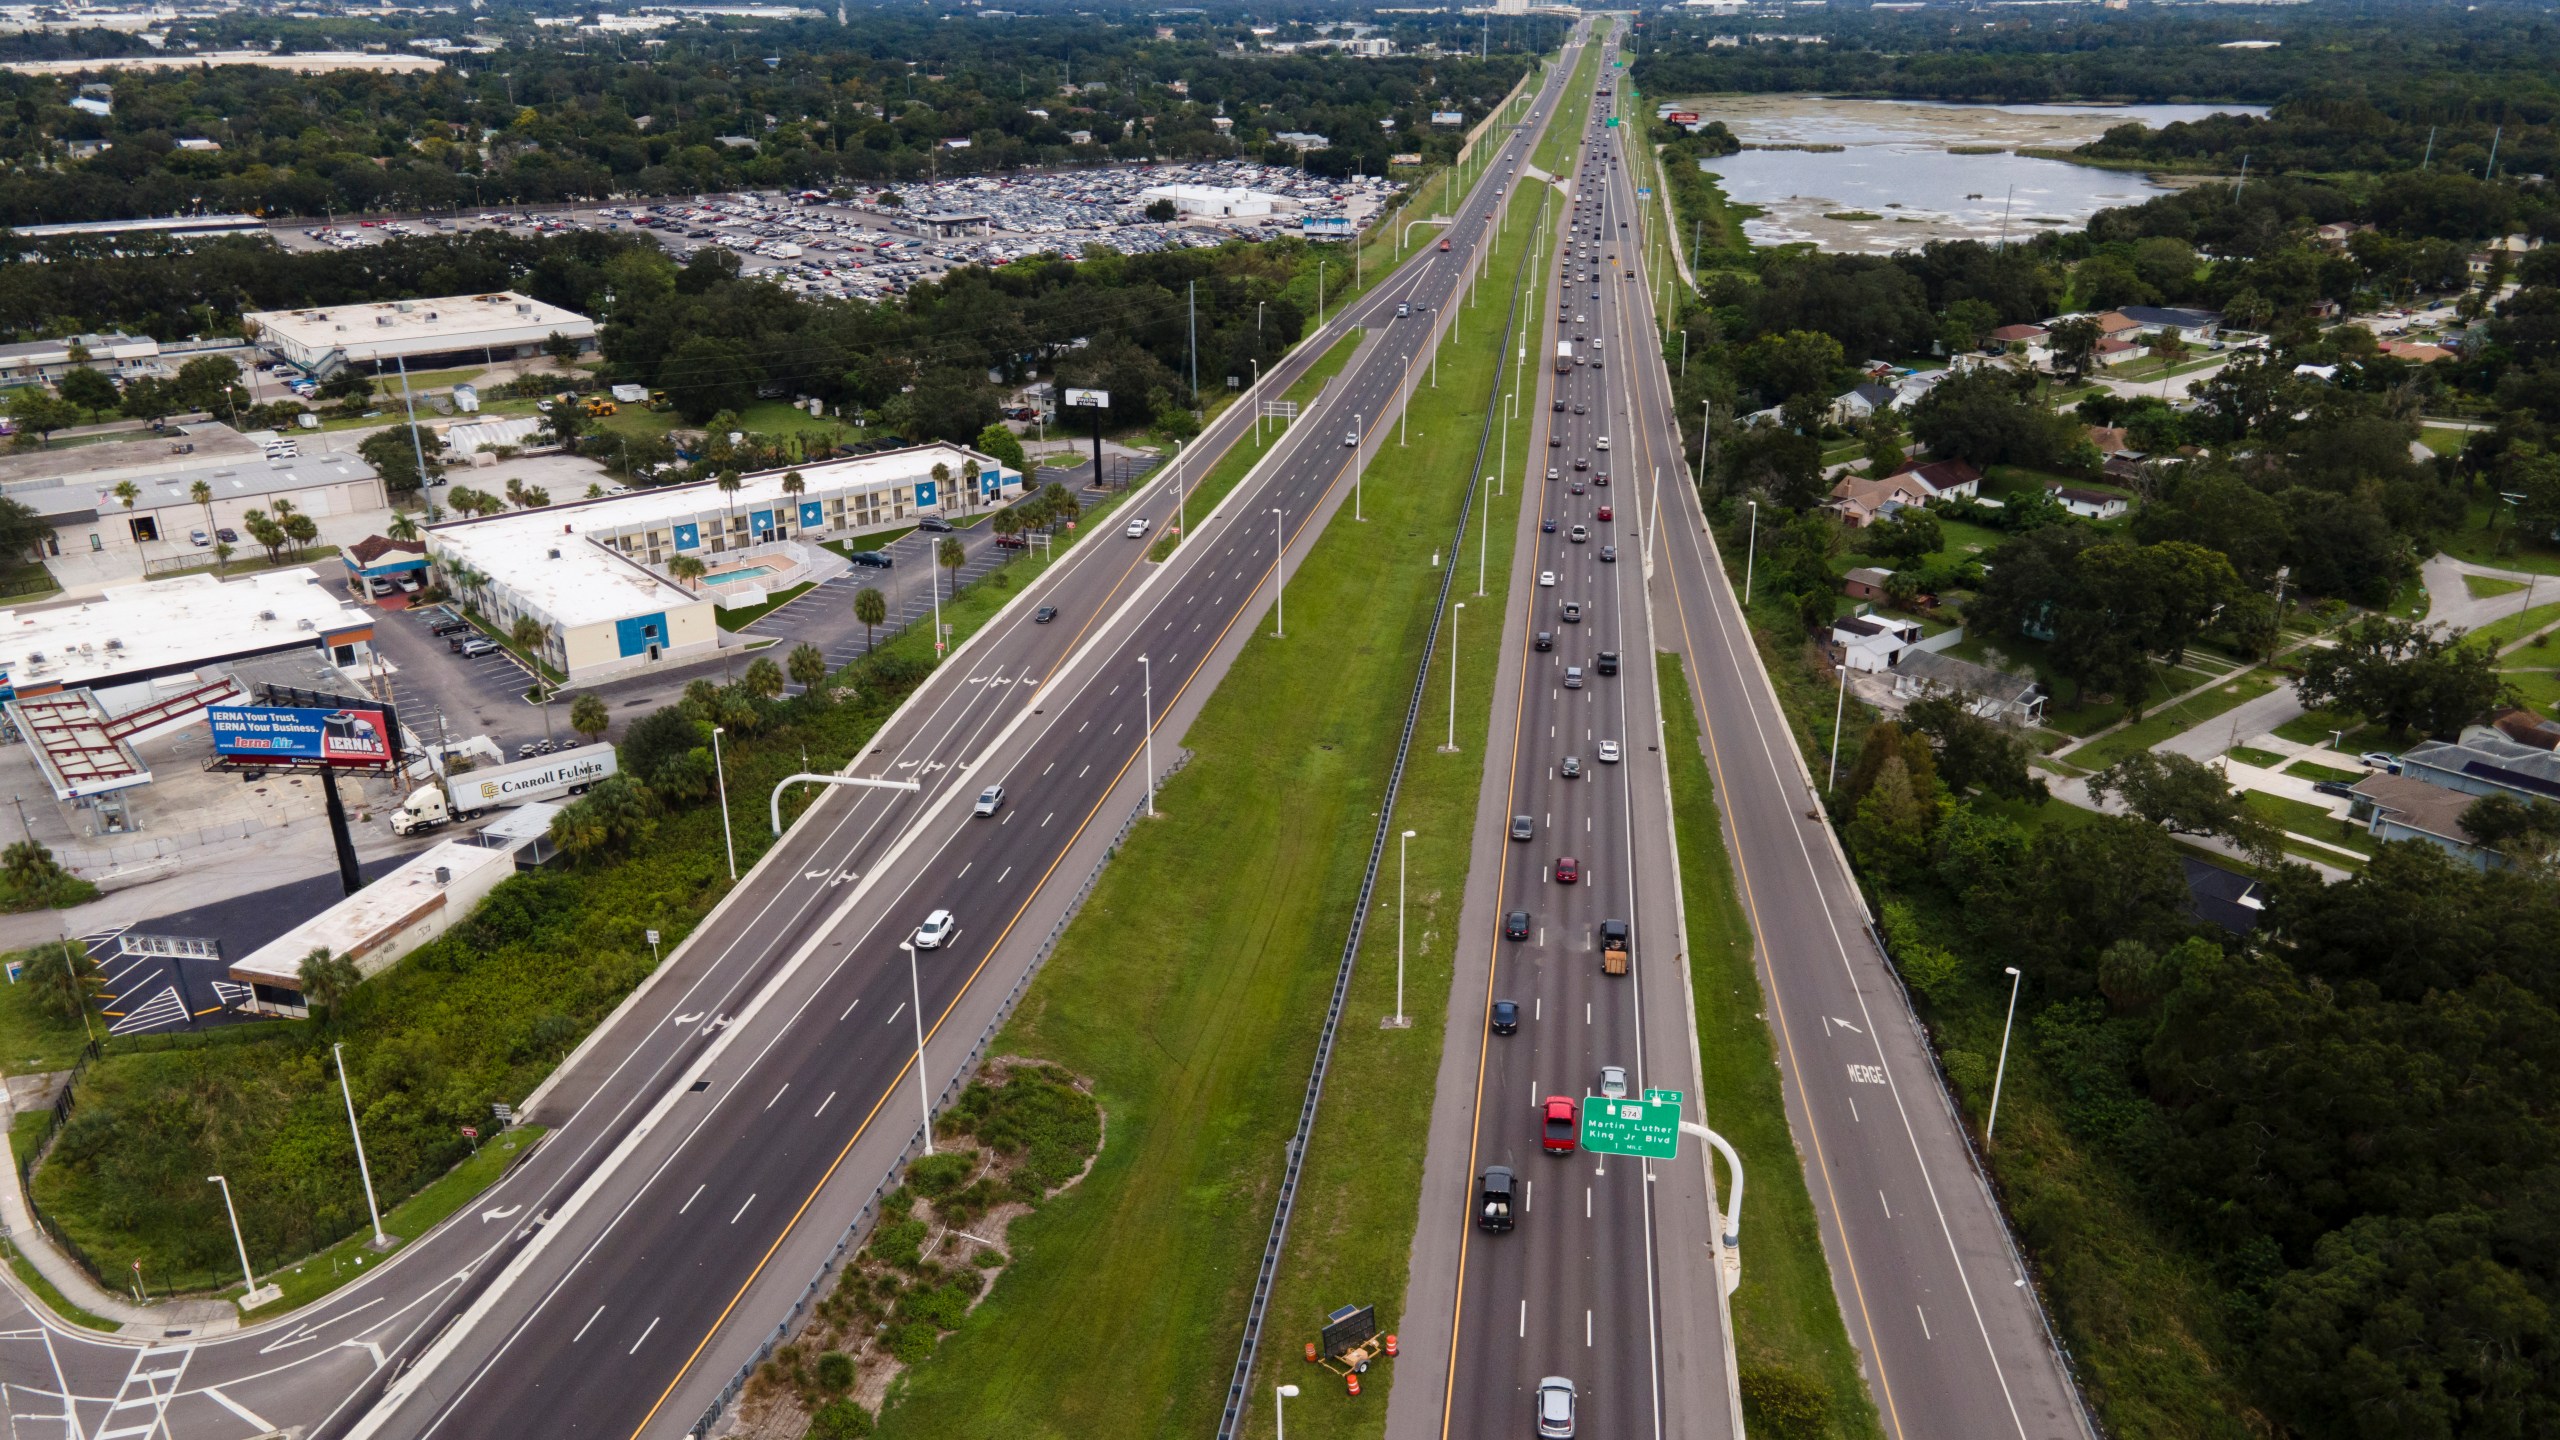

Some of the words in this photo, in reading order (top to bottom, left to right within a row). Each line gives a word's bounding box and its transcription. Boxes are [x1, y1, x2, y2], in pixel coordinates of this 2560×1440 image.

[213, 712, 244, 721] IERNA
[244, 713, 267, 721] Your
[269, 713, 299, 723] Trust,
[216, 722, 247, 731] IERNA
[247, 723, 270, 732] Your
[272, 723, 319, 733] Business.
[1847, 1064, 1886, 1084] MERGE
[1670, 1093, 1677, 1101] 5
[1588, 1119, 1625, 1130] Martin
[1634, 1124, 1672, 1134] Luther
[1589, 1130, 1614, 1140] King
[1624, 1133, 1636, 1141] Jr
[1645, 1136, 1670, 1144] Blvd
